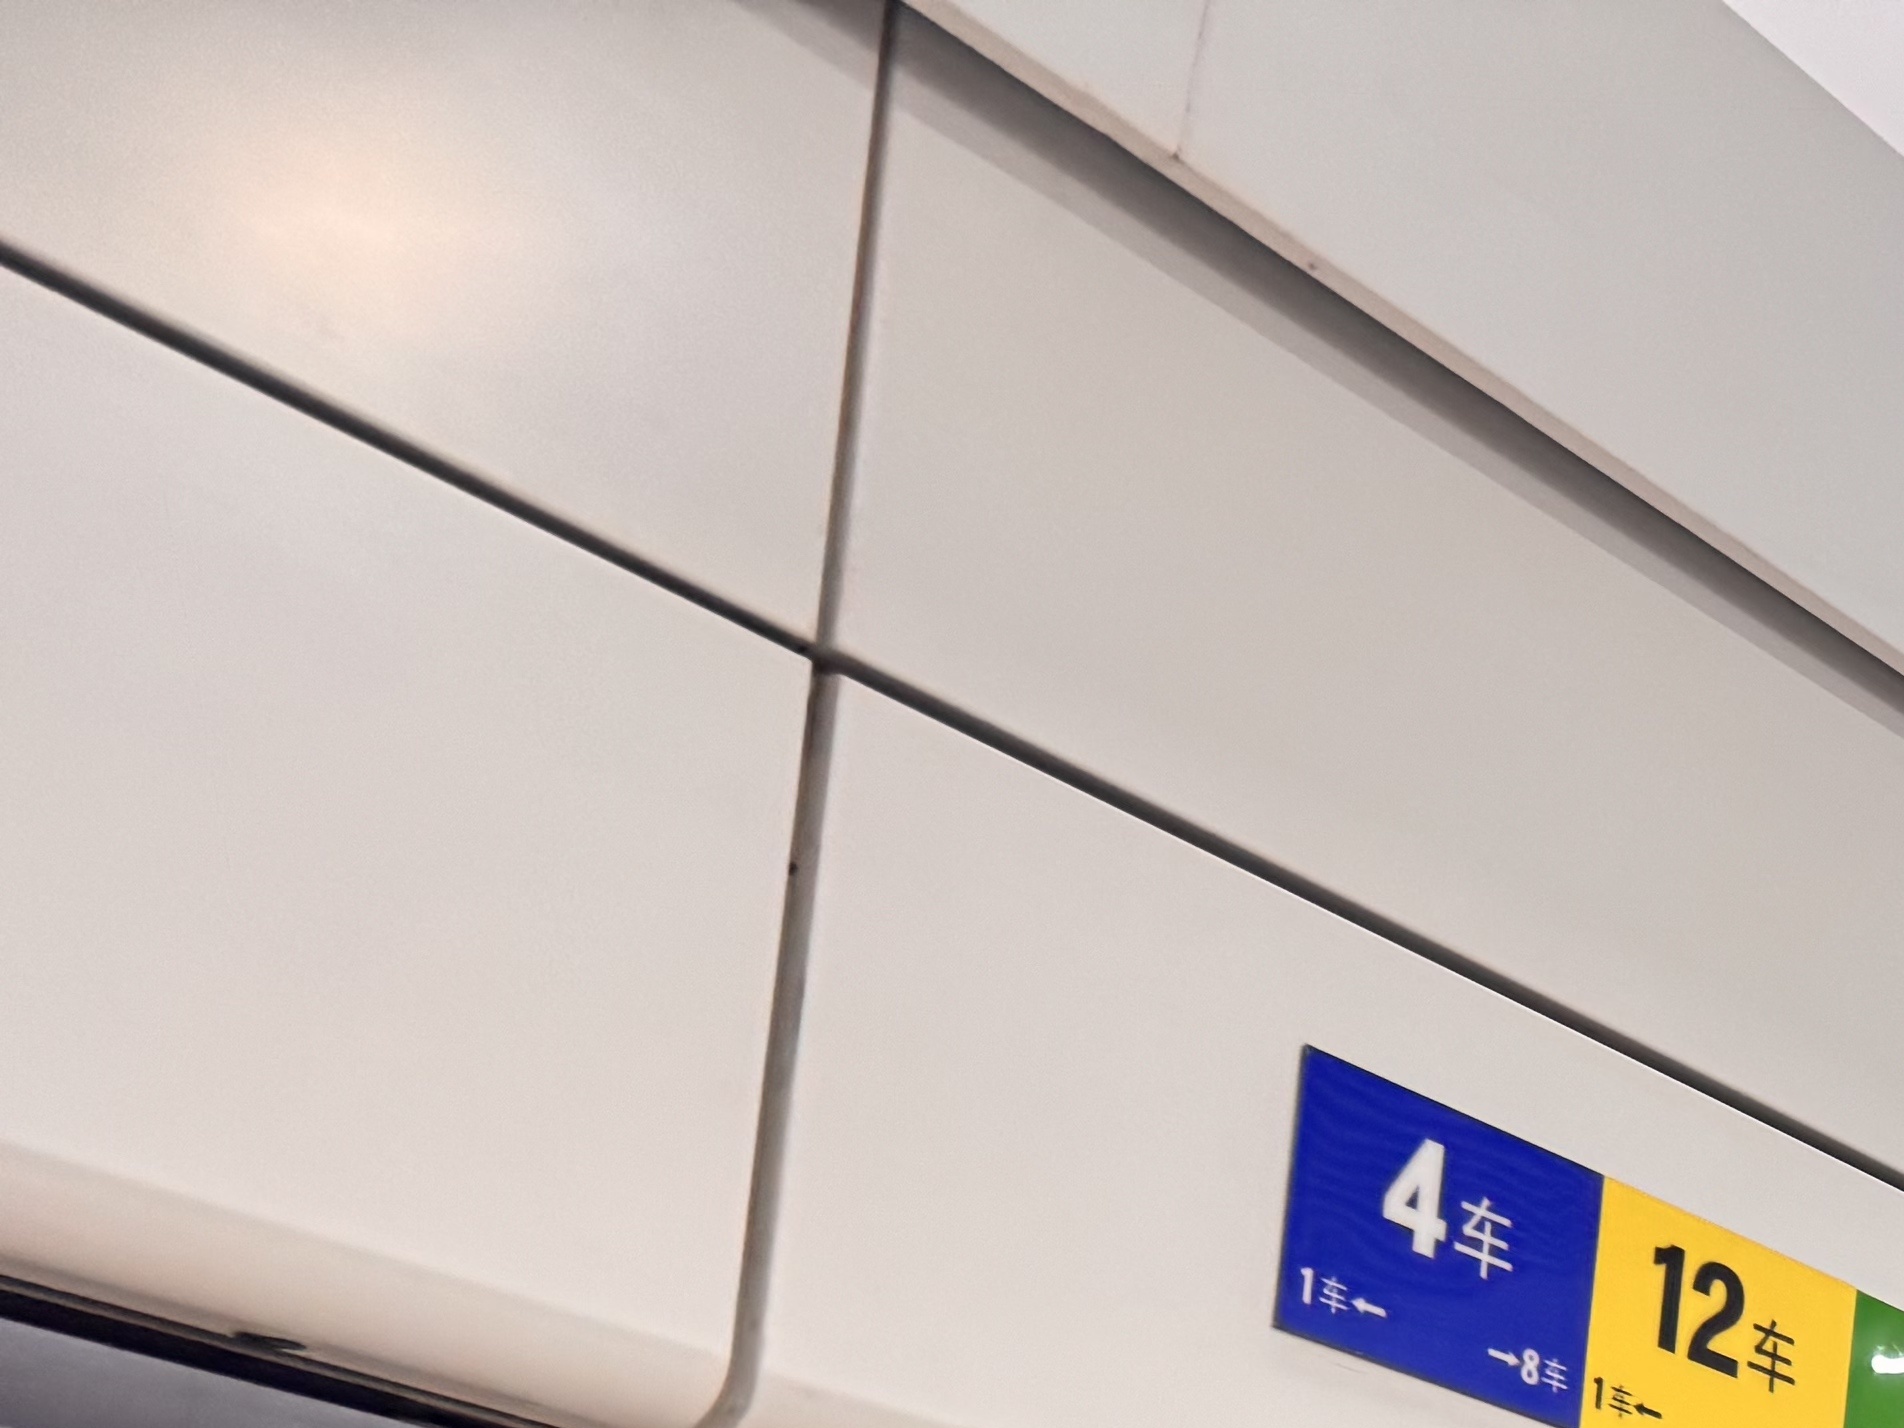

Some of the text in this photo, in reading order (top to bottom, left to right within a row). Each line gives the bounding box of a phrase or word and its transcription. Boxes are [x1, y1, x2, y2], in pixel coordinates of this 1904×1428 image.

[1382, 1137, 1514, 1280] 4车
[1300, 1266, 1350, 1315] 1车
[1653, 1244, 1796, 1394] 12车
[1520, 1347, 1569, 1393] 8车
[1593, 1376, 1634, 1419] 1车
